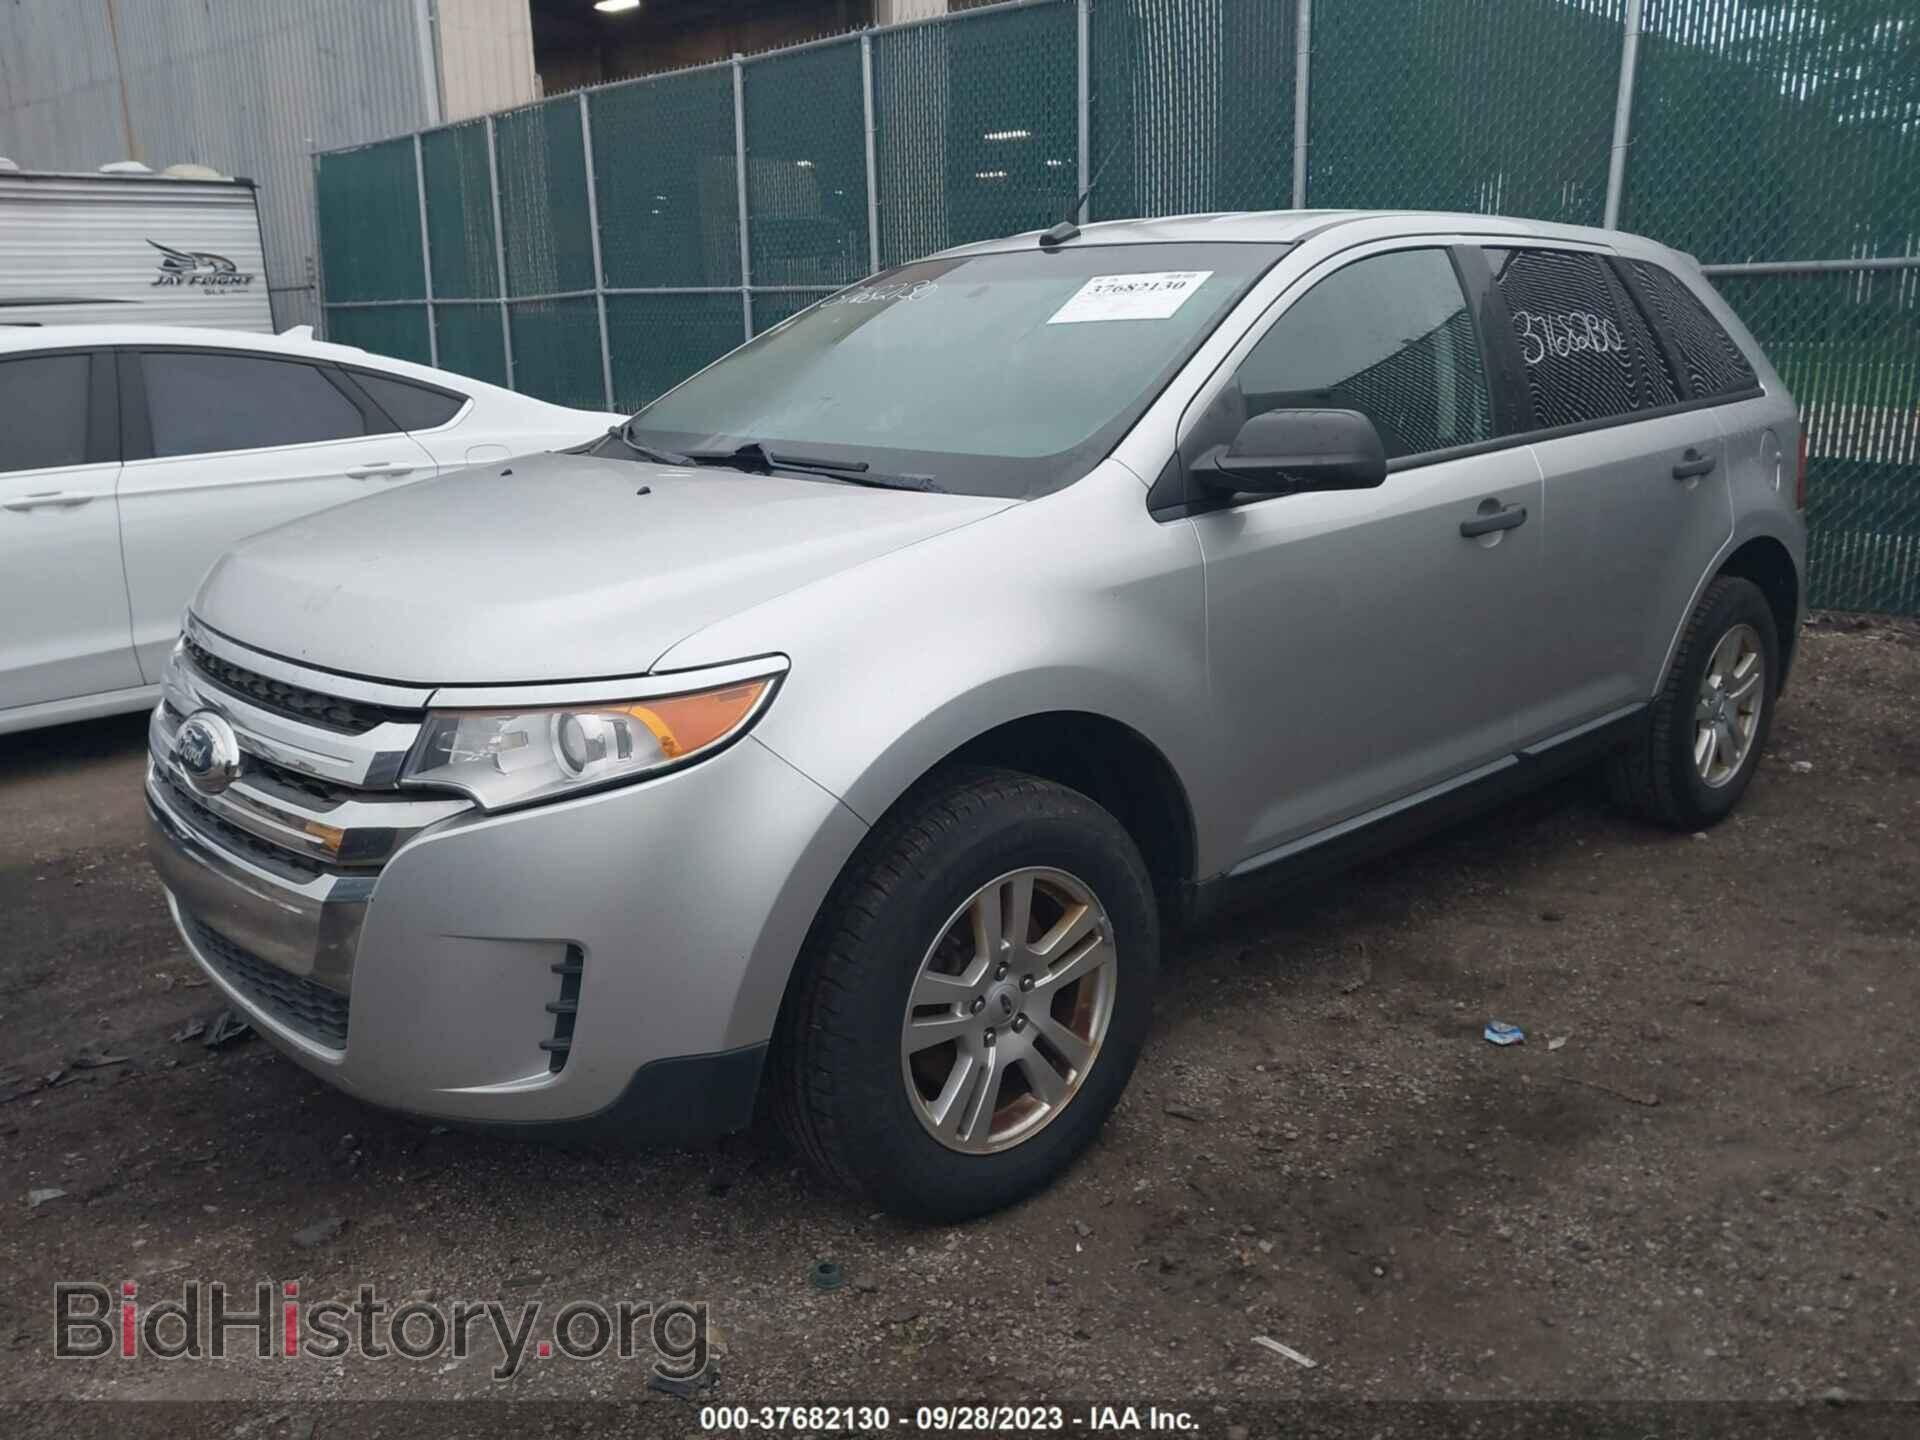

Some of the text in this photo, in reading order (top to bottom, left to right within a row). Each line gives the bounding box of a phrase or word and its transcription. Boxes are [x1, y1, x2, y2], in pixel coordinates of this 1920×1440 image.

[151, 273, 253, 286] JAY FLIGHT
[1088, 280, 1187, 294] 37682130
